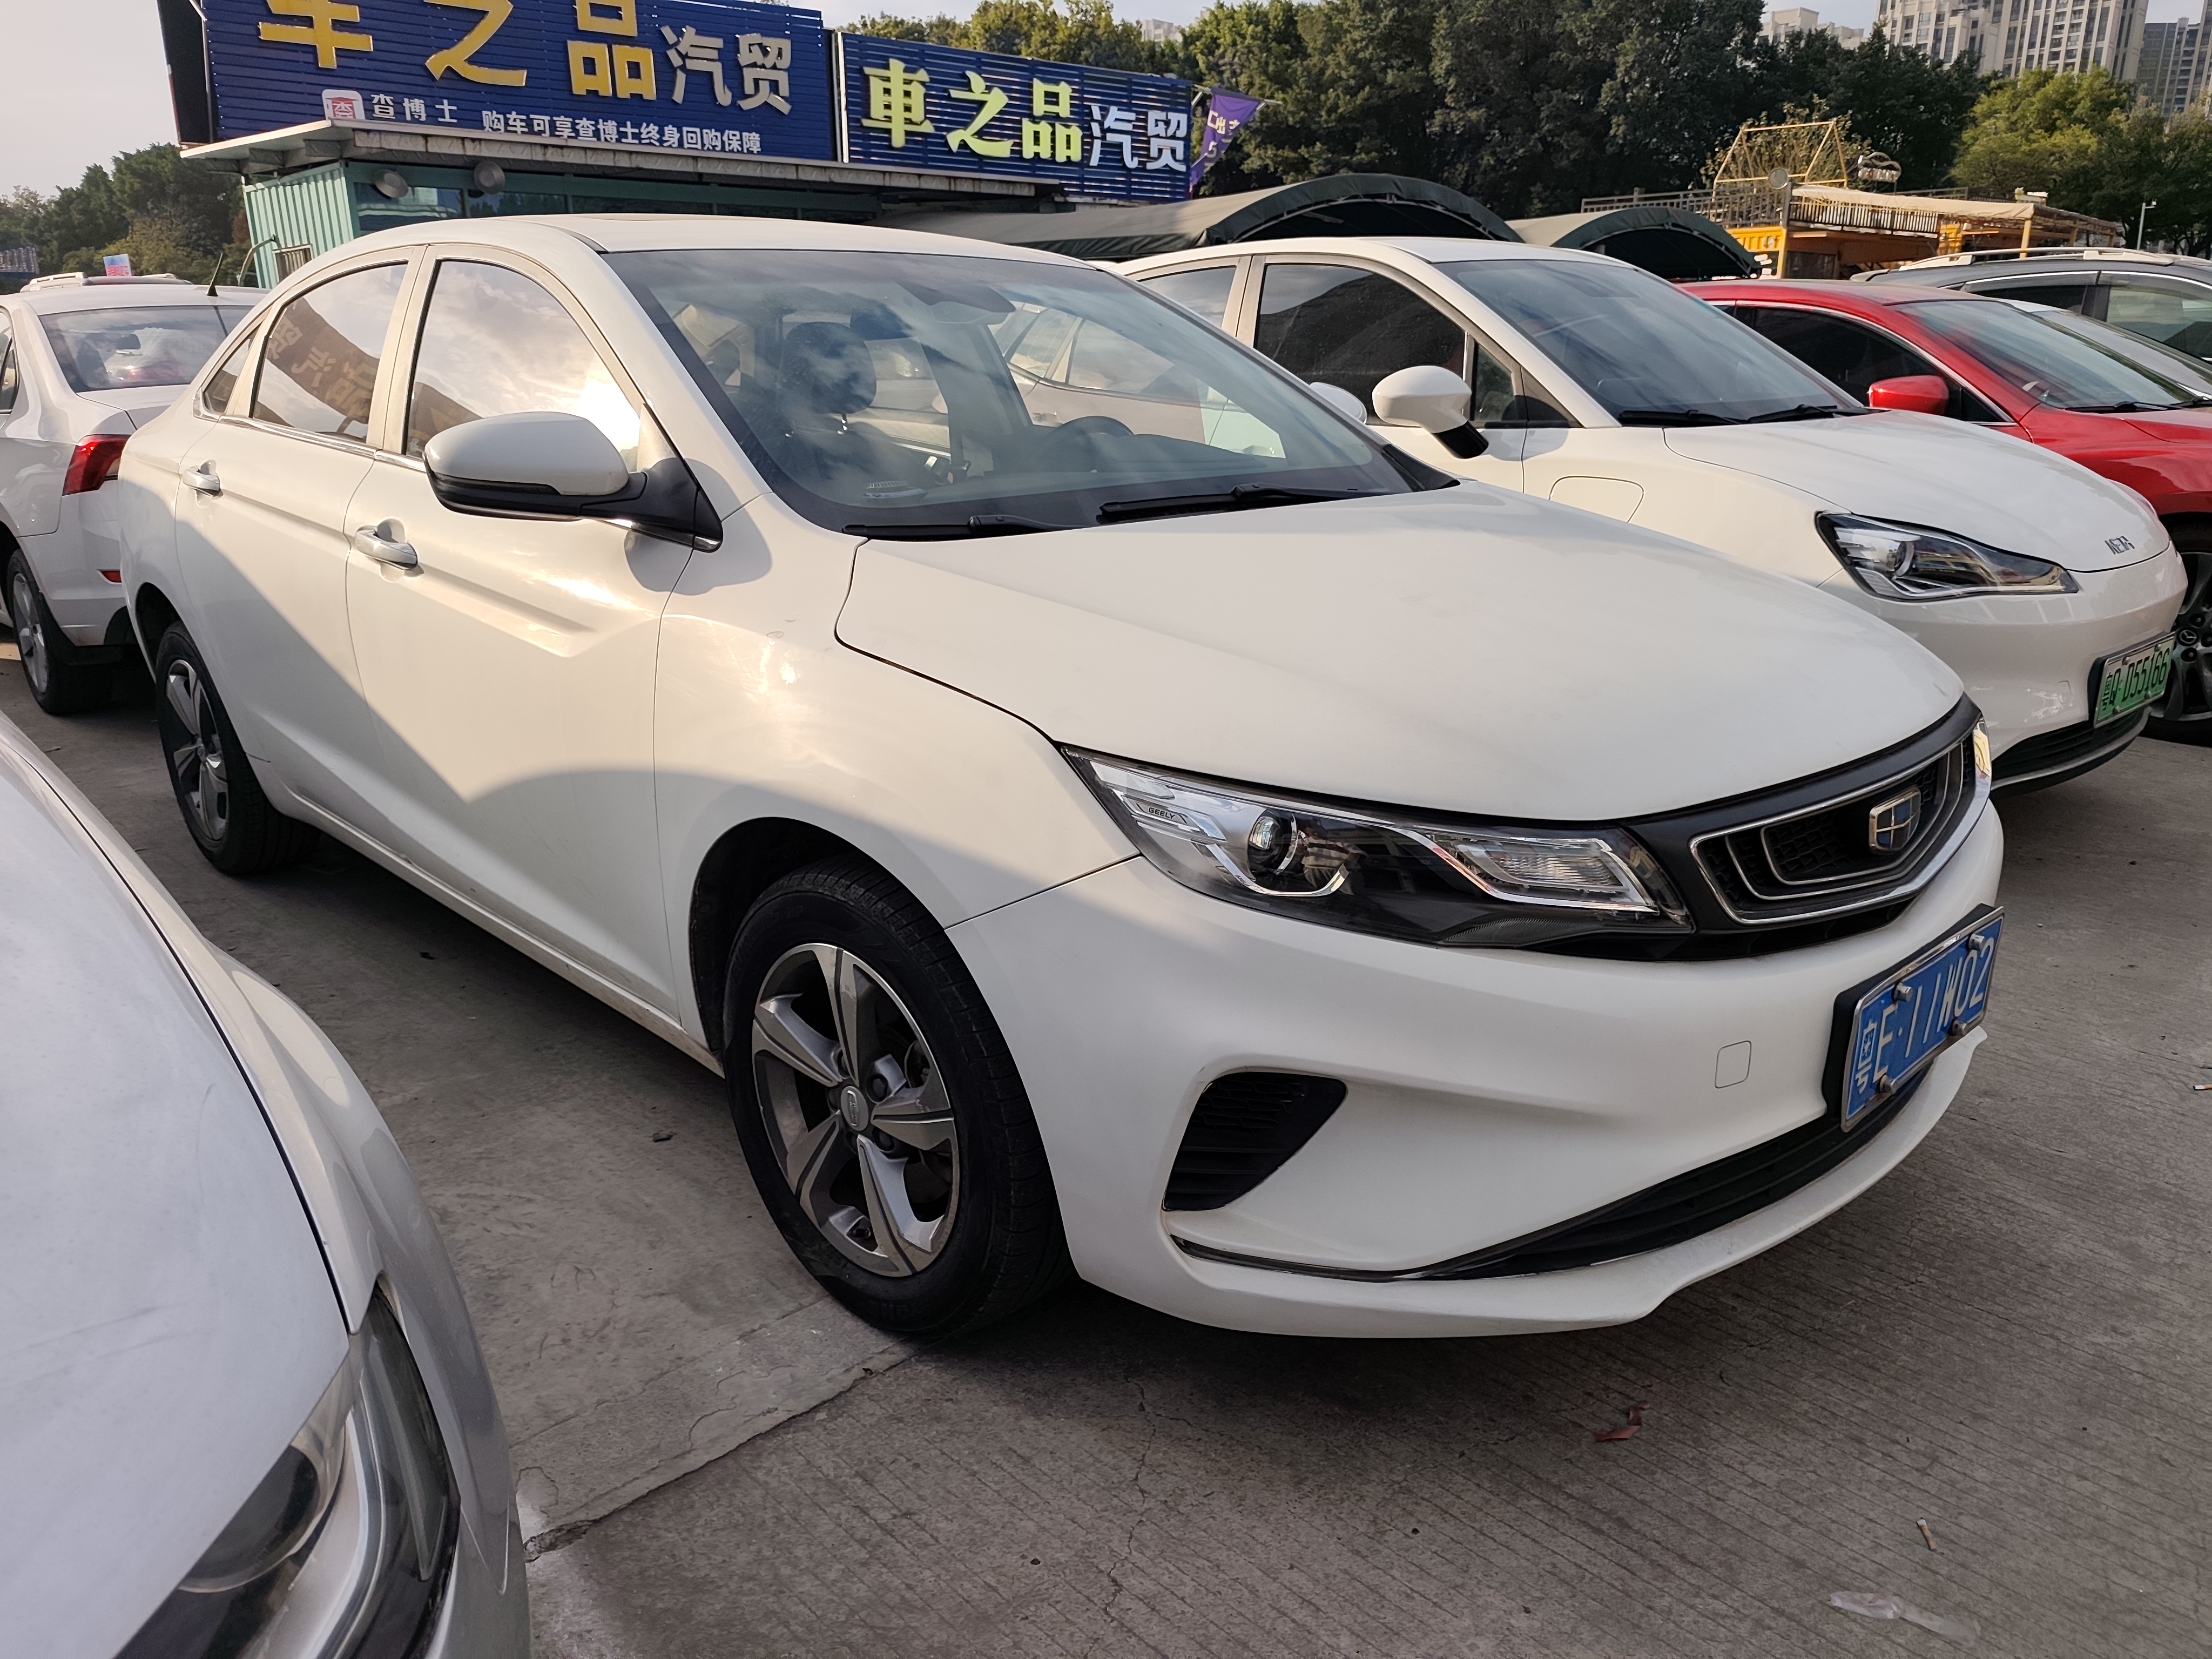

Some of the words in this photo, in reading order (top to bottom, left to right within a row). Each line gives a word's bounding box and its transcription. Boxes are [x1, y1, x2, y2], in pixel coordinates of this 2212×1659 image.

[370, 93, 457, 123] 查博士
[482, 111, 761, 153] 购车可享查博士终身回购保障
[1148, 807, 1176, 819] GEELY
